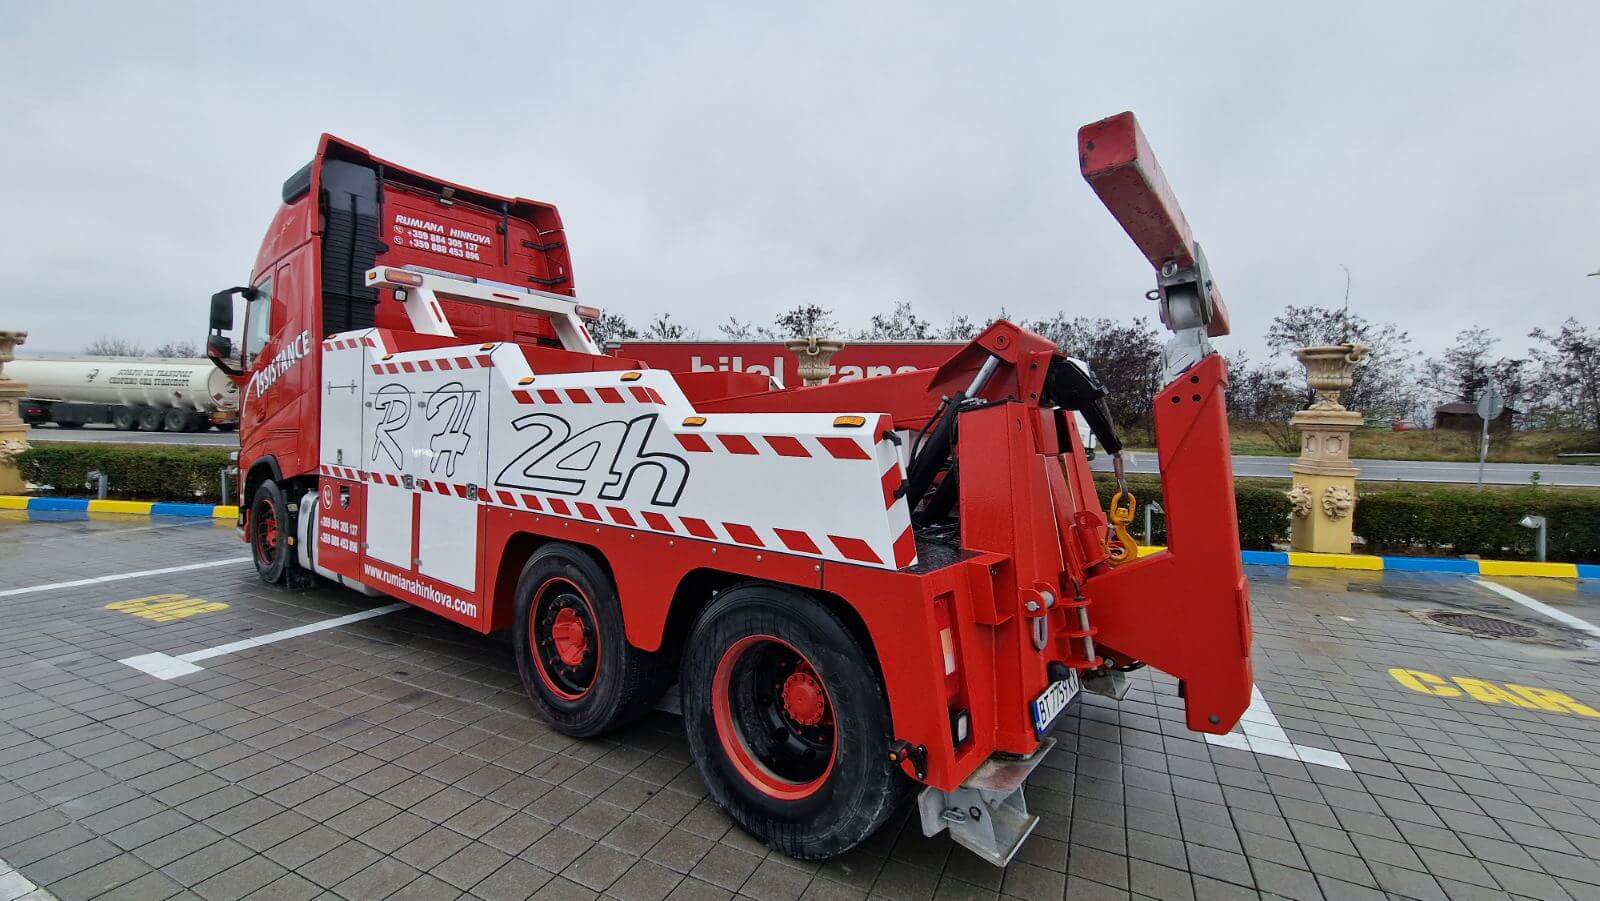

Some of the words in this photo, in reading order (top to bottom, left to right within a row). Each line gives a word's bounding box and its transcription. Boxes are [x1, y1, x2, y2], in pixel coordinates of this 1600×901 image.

[395, 214, 444, 233] RUMIANA
[450, 228, 491, 245] HINKOVA
[407, 229, 429, 240] +359
[464, 242, 479, 252] 137
[409, 239, 429, 250] +359
[372, 383, 411, 471] R
[494, 412, 690, 507] 24h
[364, 563, 477, 618] www.rumianahinkova.com
[1387, 668, 1600, 718] CAR
